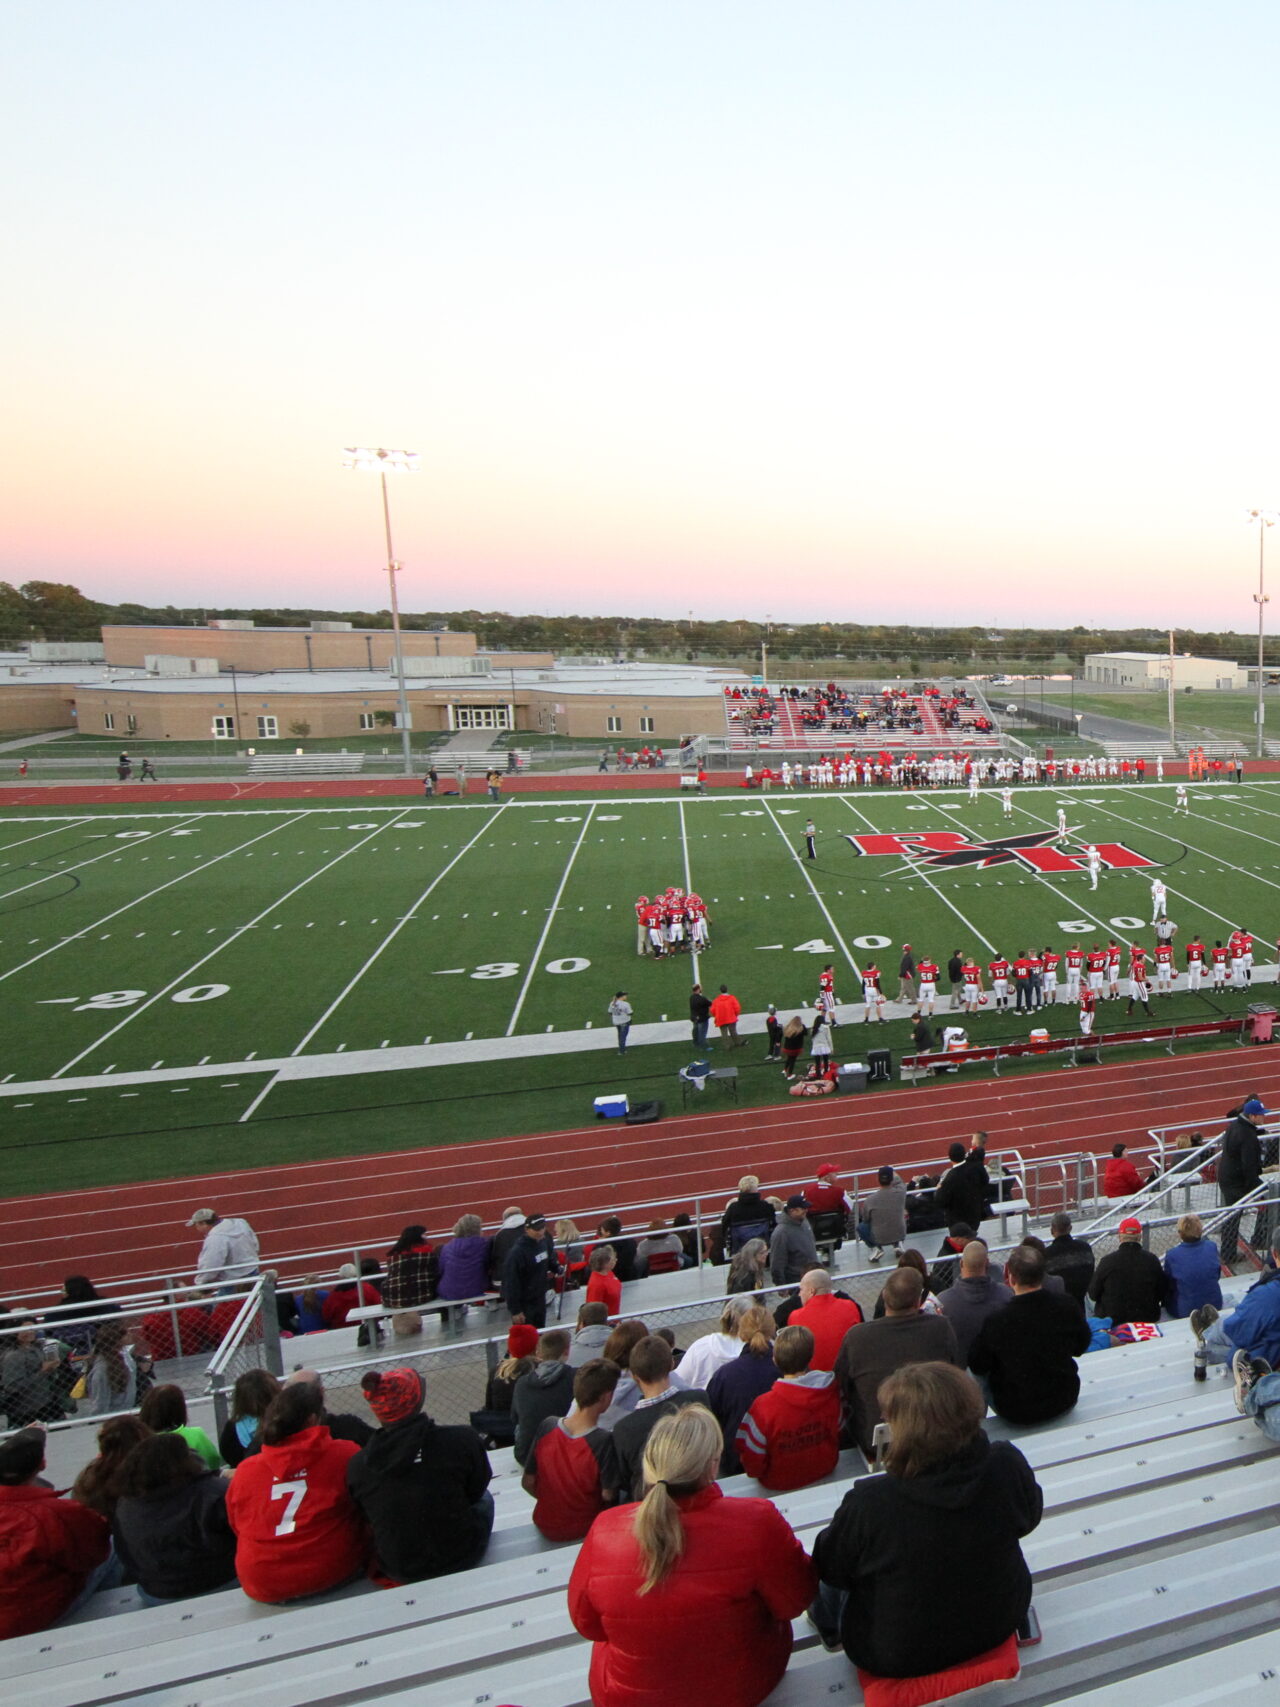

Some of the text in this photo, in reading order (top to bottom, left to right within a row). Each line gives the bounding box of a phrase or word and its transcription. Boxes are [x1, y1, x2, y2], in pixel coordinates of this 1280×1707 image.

[672, 914, 683, 922] 27
[1057, 917, 1145, 933] 50
[793, 935, 892, 953] 40
[1193, 950, 1199, 959] 6
[470, 957, 591, 979] 30
[73, 984, 230, 1011] 20
[271, 1479, 308, 1536] 7
